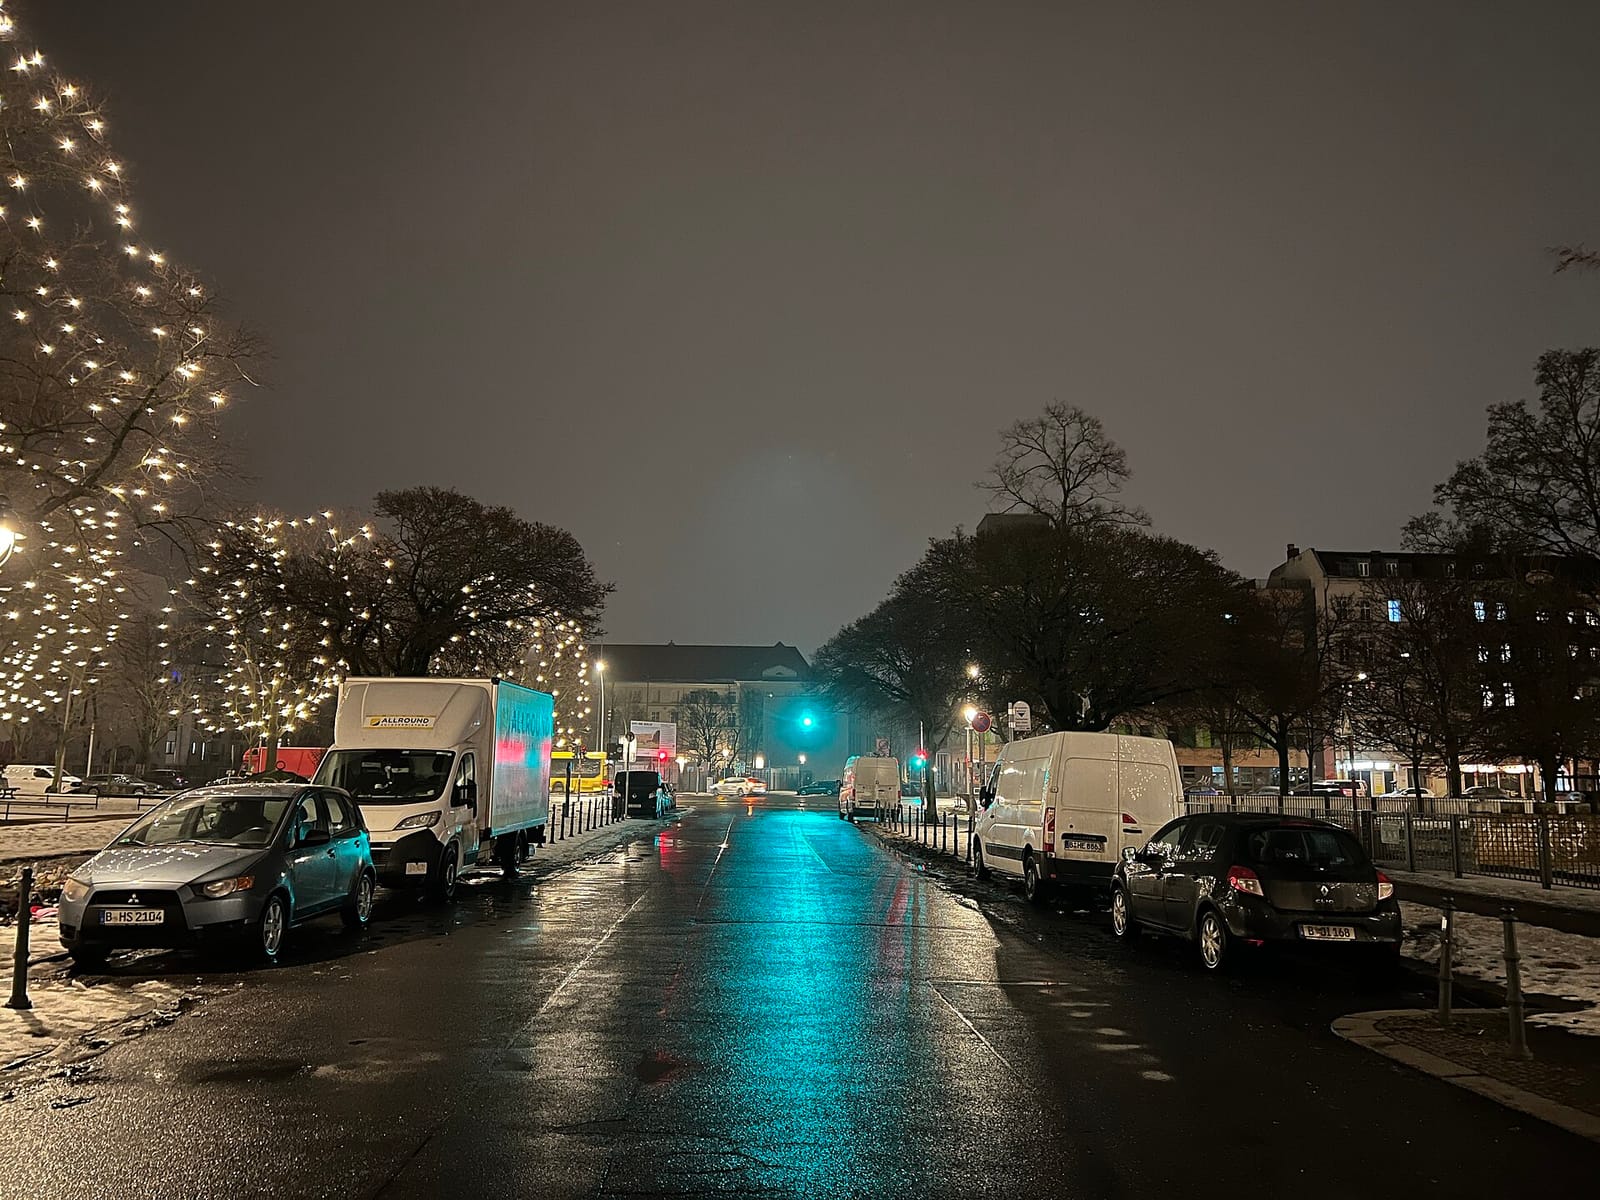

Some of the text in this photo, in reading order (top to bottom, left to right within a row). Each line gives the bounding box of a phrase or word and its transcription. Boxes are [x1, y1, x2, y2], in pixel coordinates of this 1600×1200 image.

[105, 911, 162, 922] B HS 2104
[1307, 926, 1315, 936] B
[1333, 927, 1351, 938] 168
